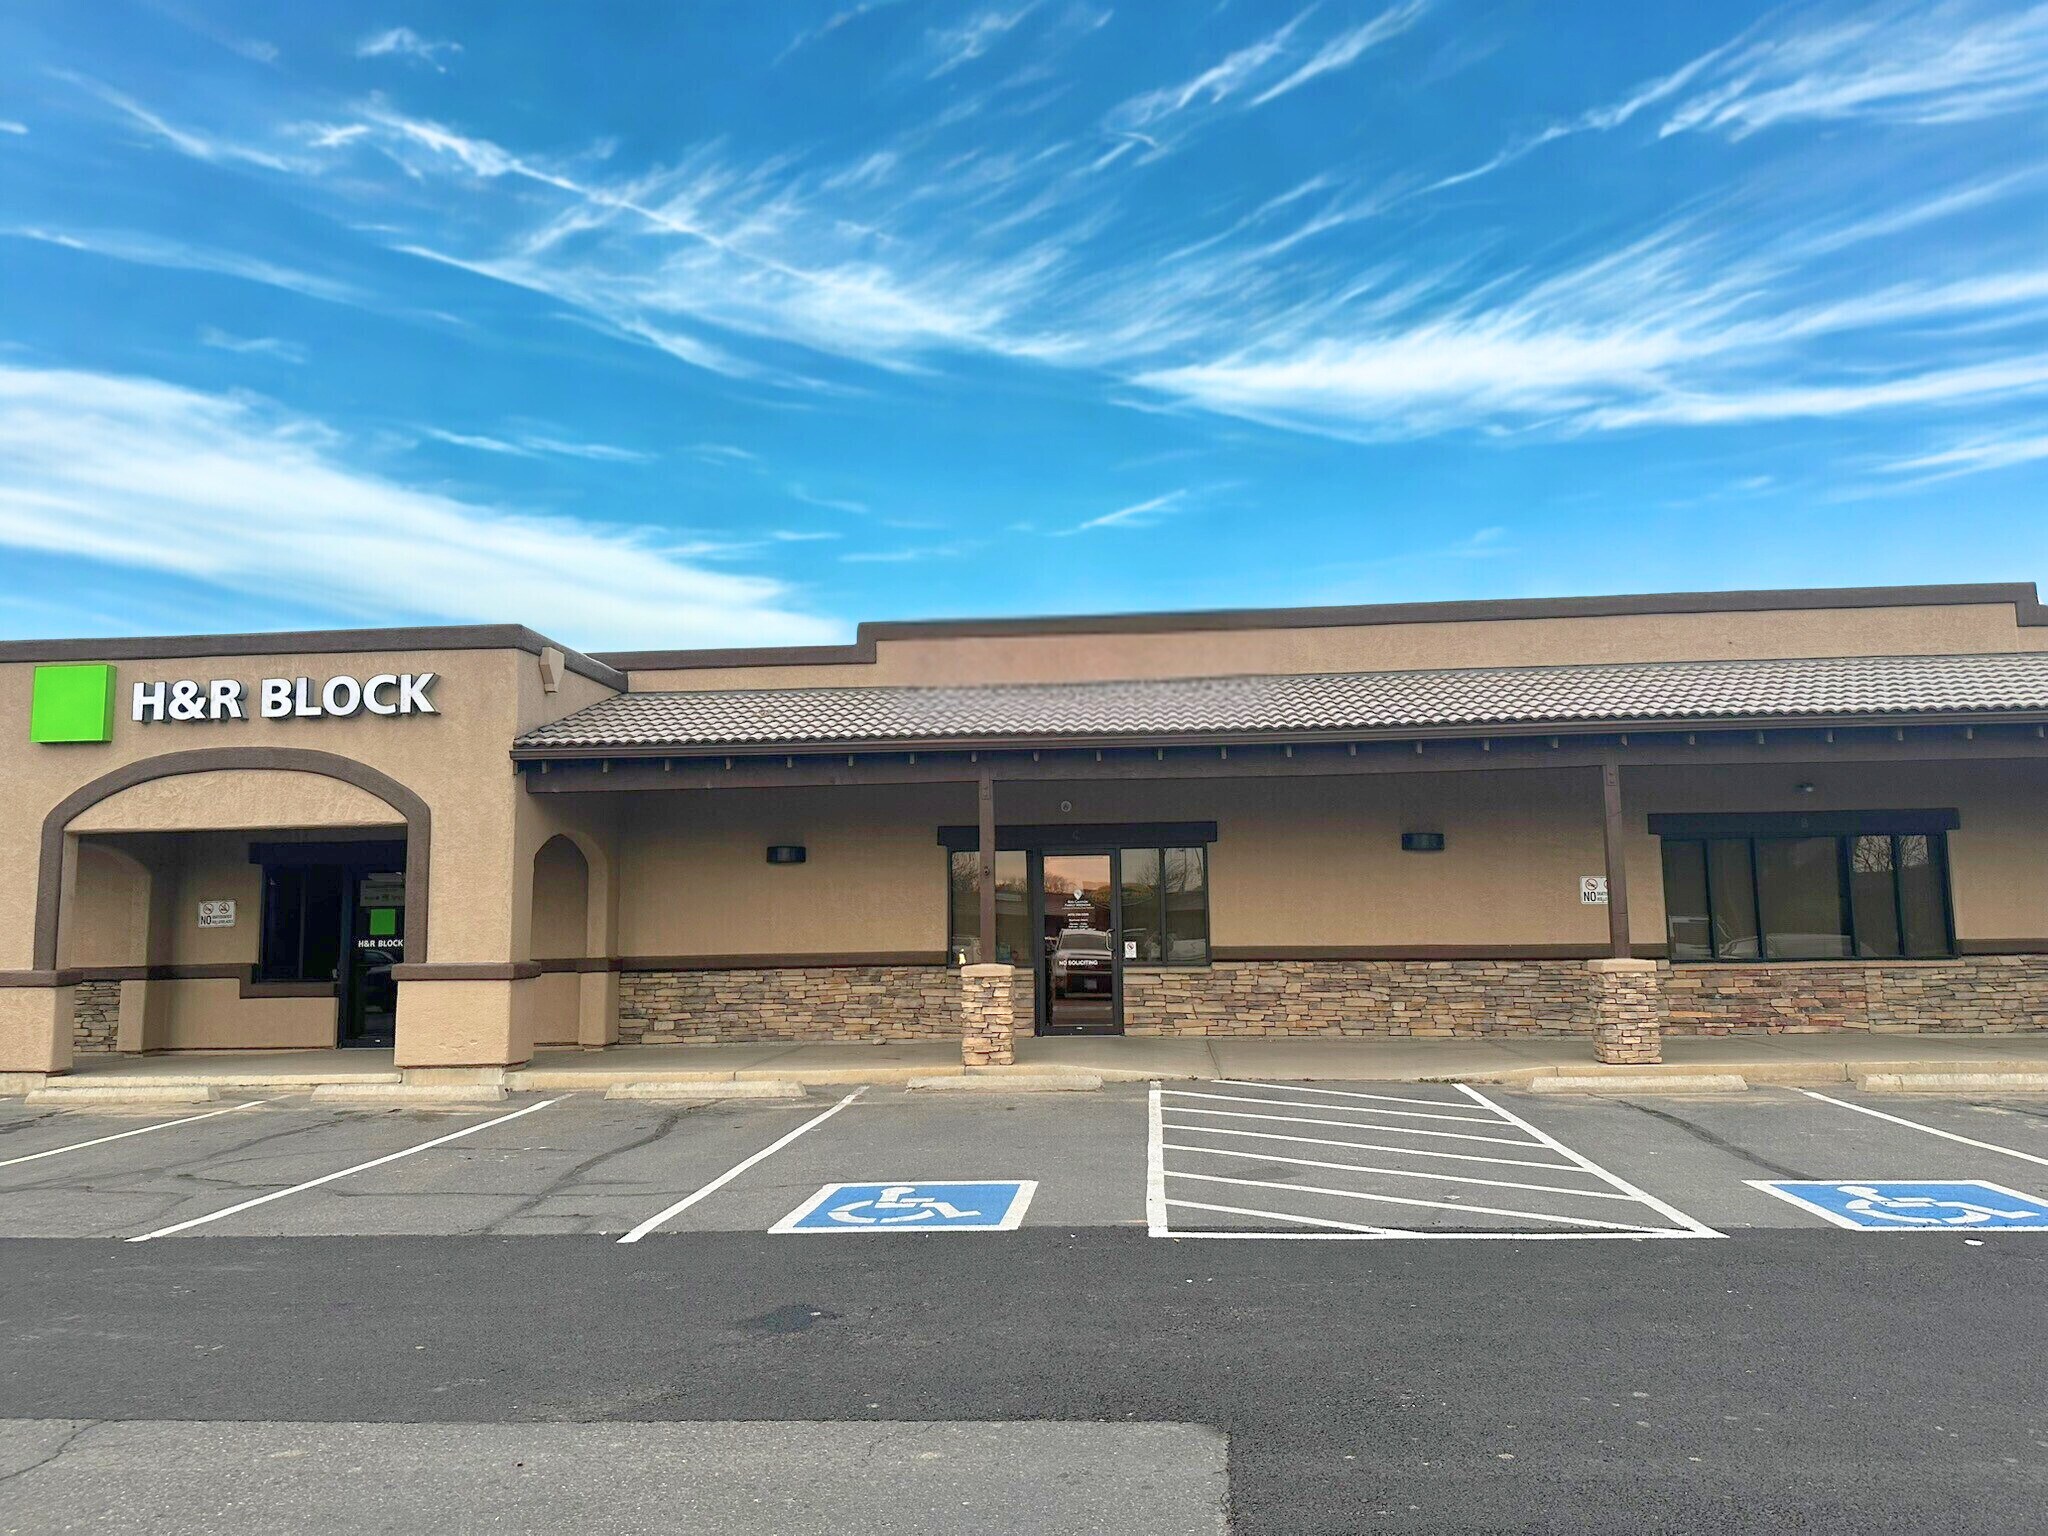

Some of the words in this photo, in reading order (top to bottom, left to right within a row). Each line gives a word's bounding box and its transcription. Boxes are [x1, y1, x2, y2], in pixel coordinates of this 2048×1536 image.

[132, 679, 246, 722] H&R
[260, 672, 439, 718] BLOCK
[1583, 891, 1596, 901] NO
[200, 915, 212, 925] NO
[378, 939, 403, 947] BLOCK
